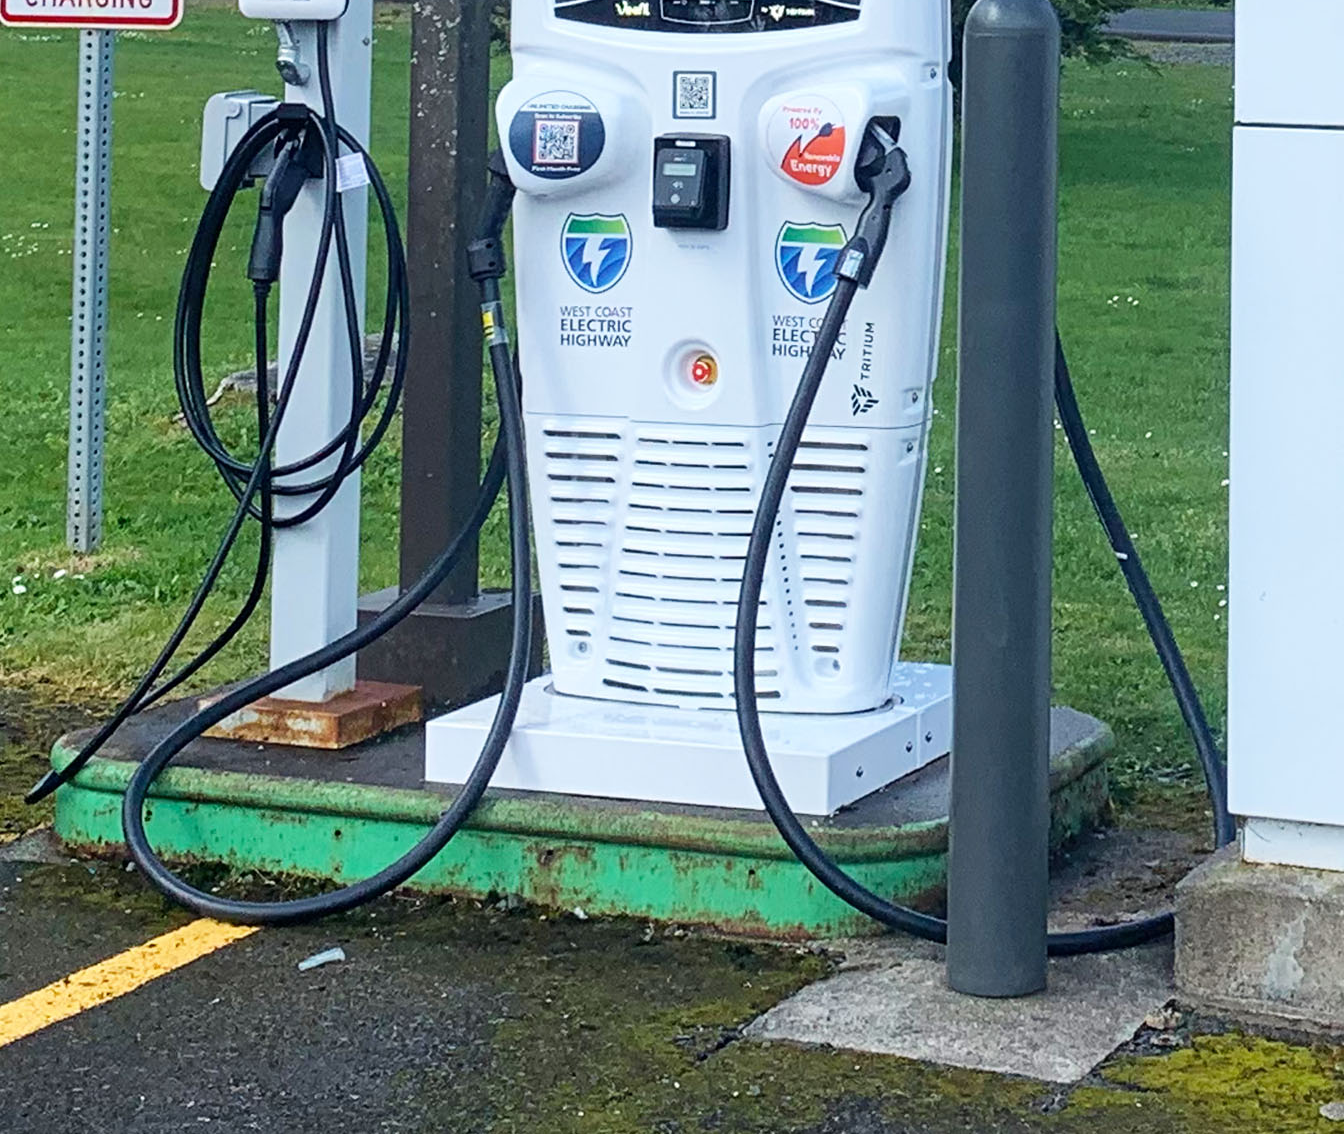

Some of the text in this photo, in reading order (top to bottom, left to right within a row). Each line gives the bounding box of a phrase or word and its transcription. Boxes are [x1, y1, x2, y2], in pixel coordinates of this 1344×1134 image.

[790, 117, 820, 130] 100%
[790, 159, 833, 178] Energy
[560, 305, 633, 318] WEST COAST
[560, 318, 632, 333] ELECTRIC
[772, 315, 805, 328] WEST
[560, 333, 632, 347] HIGHWAY
[773, 328, 847, 346] ELECTC
[772, 343, 847, 360] HIGHAY
[860, 322, 875, 381] TRITIUM
